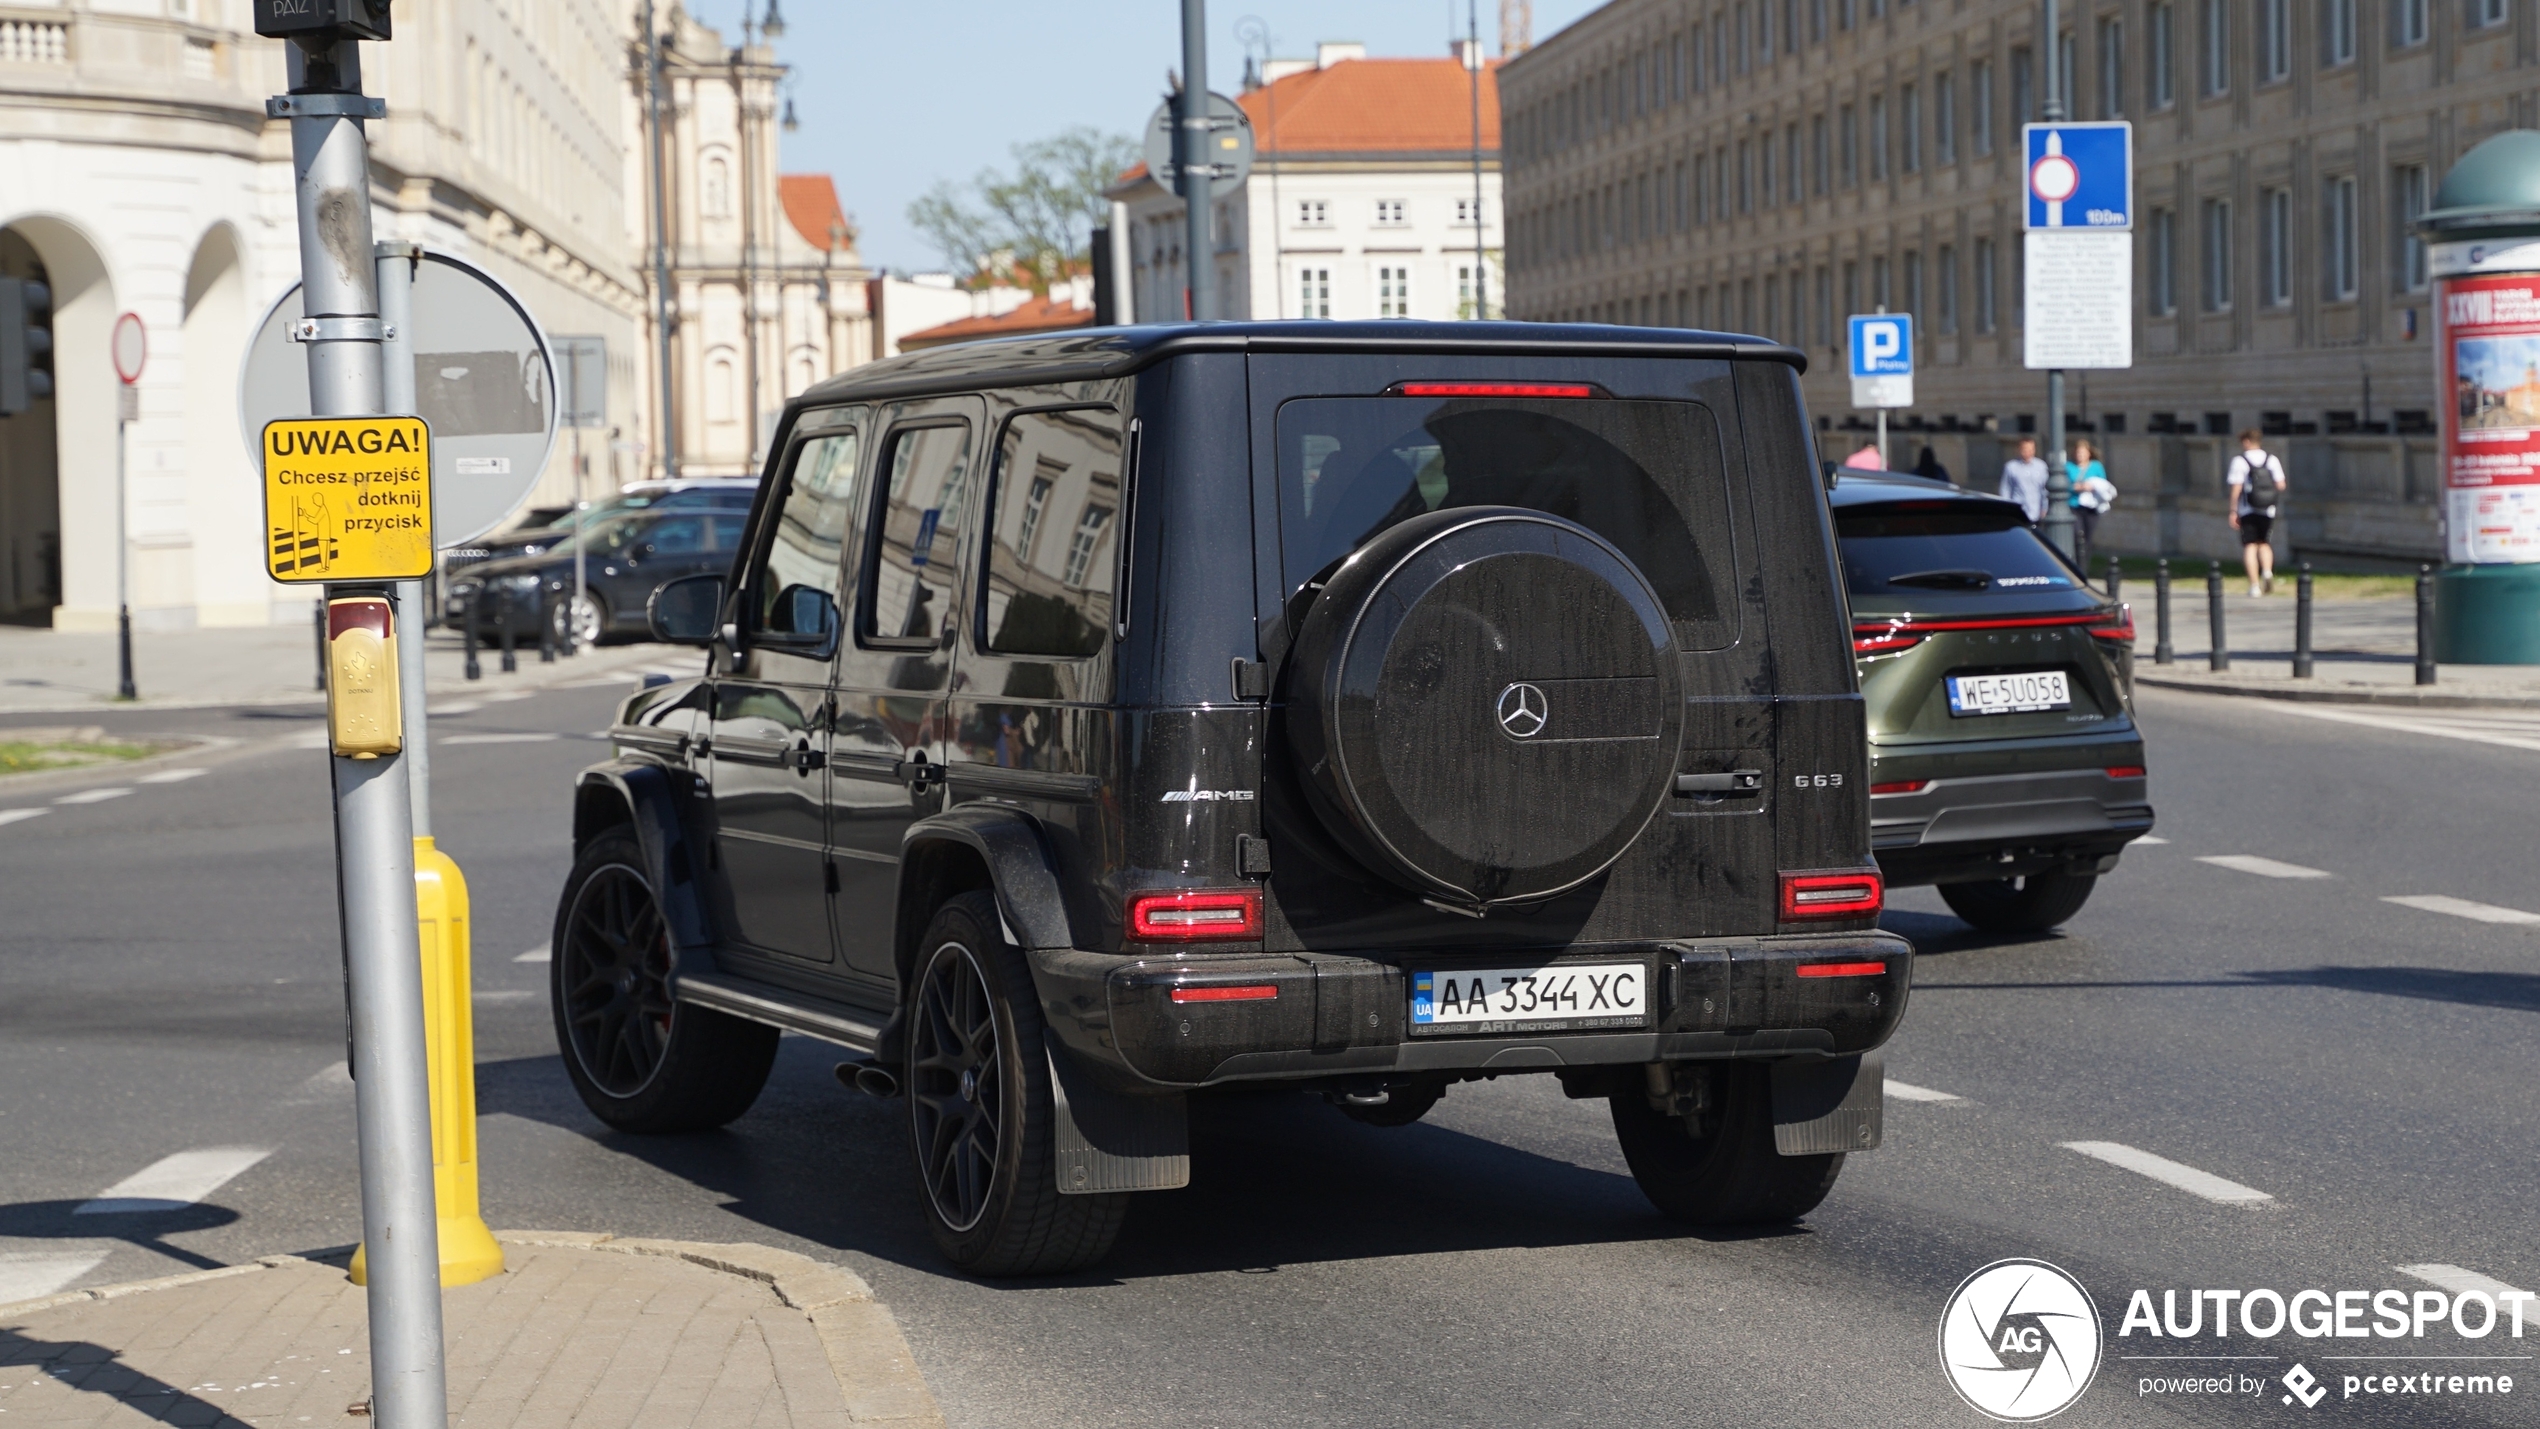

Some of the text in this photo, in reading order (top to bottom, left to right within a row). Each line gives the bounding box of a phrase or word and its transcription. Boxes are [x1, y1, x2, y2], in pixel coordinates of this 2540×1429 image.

[2086, 209, 2125, 225] 100m
[1863, 321, 1900, 372] P
[272, 428, 420, 456] UWAGA!
[279, 467, 421, 486] Chcesz przejść
[358, 490, 421, 508] dotknij
[345, 515, 422, 533] przycisk
[1963, 680, 1992, 705] WE
[1795, 773, 1843, 788] G 63
[1193, 790, 1254, 801] AMG
[1440, 973, 1635, 1015] AA 3344 XC
[1416, 1003, 1432, 1016] UA
[1517, 1021, 1568, 1031] MOTORS
